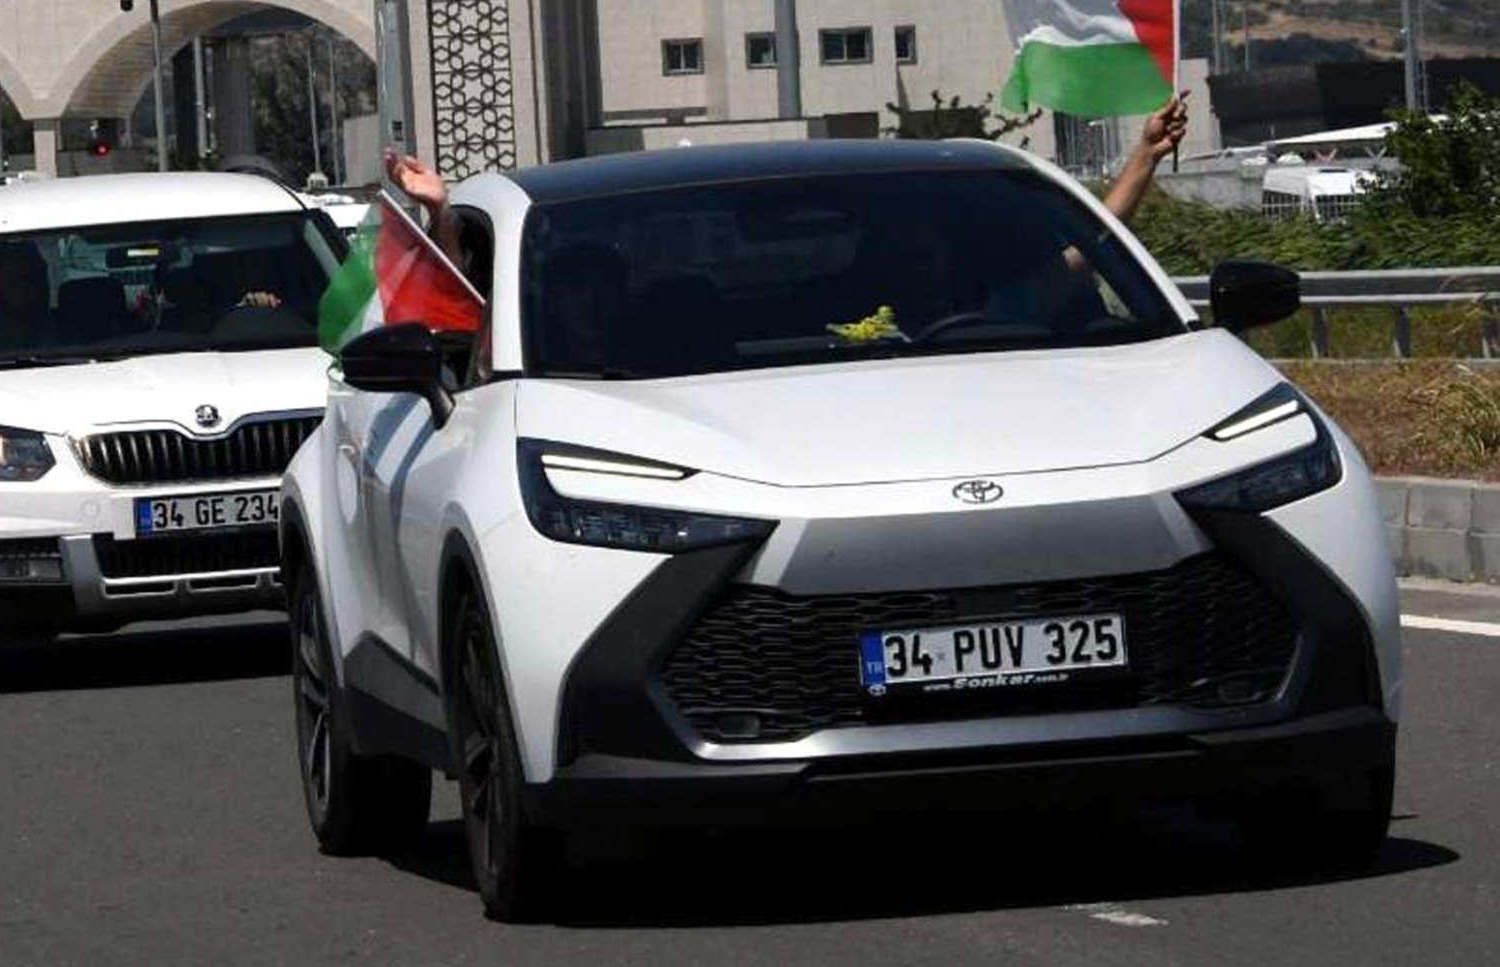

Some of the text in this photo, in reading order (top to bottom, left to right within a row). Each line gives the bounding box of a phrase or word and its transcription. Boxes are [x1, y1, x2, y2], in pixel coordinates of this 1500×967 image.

[153, 493, 279, 528] 34 GE 234
[884, 634, 933, 677] 34
[953, 626, 1025, 672] PUV
[1043, 618, 1118, 665] 325
